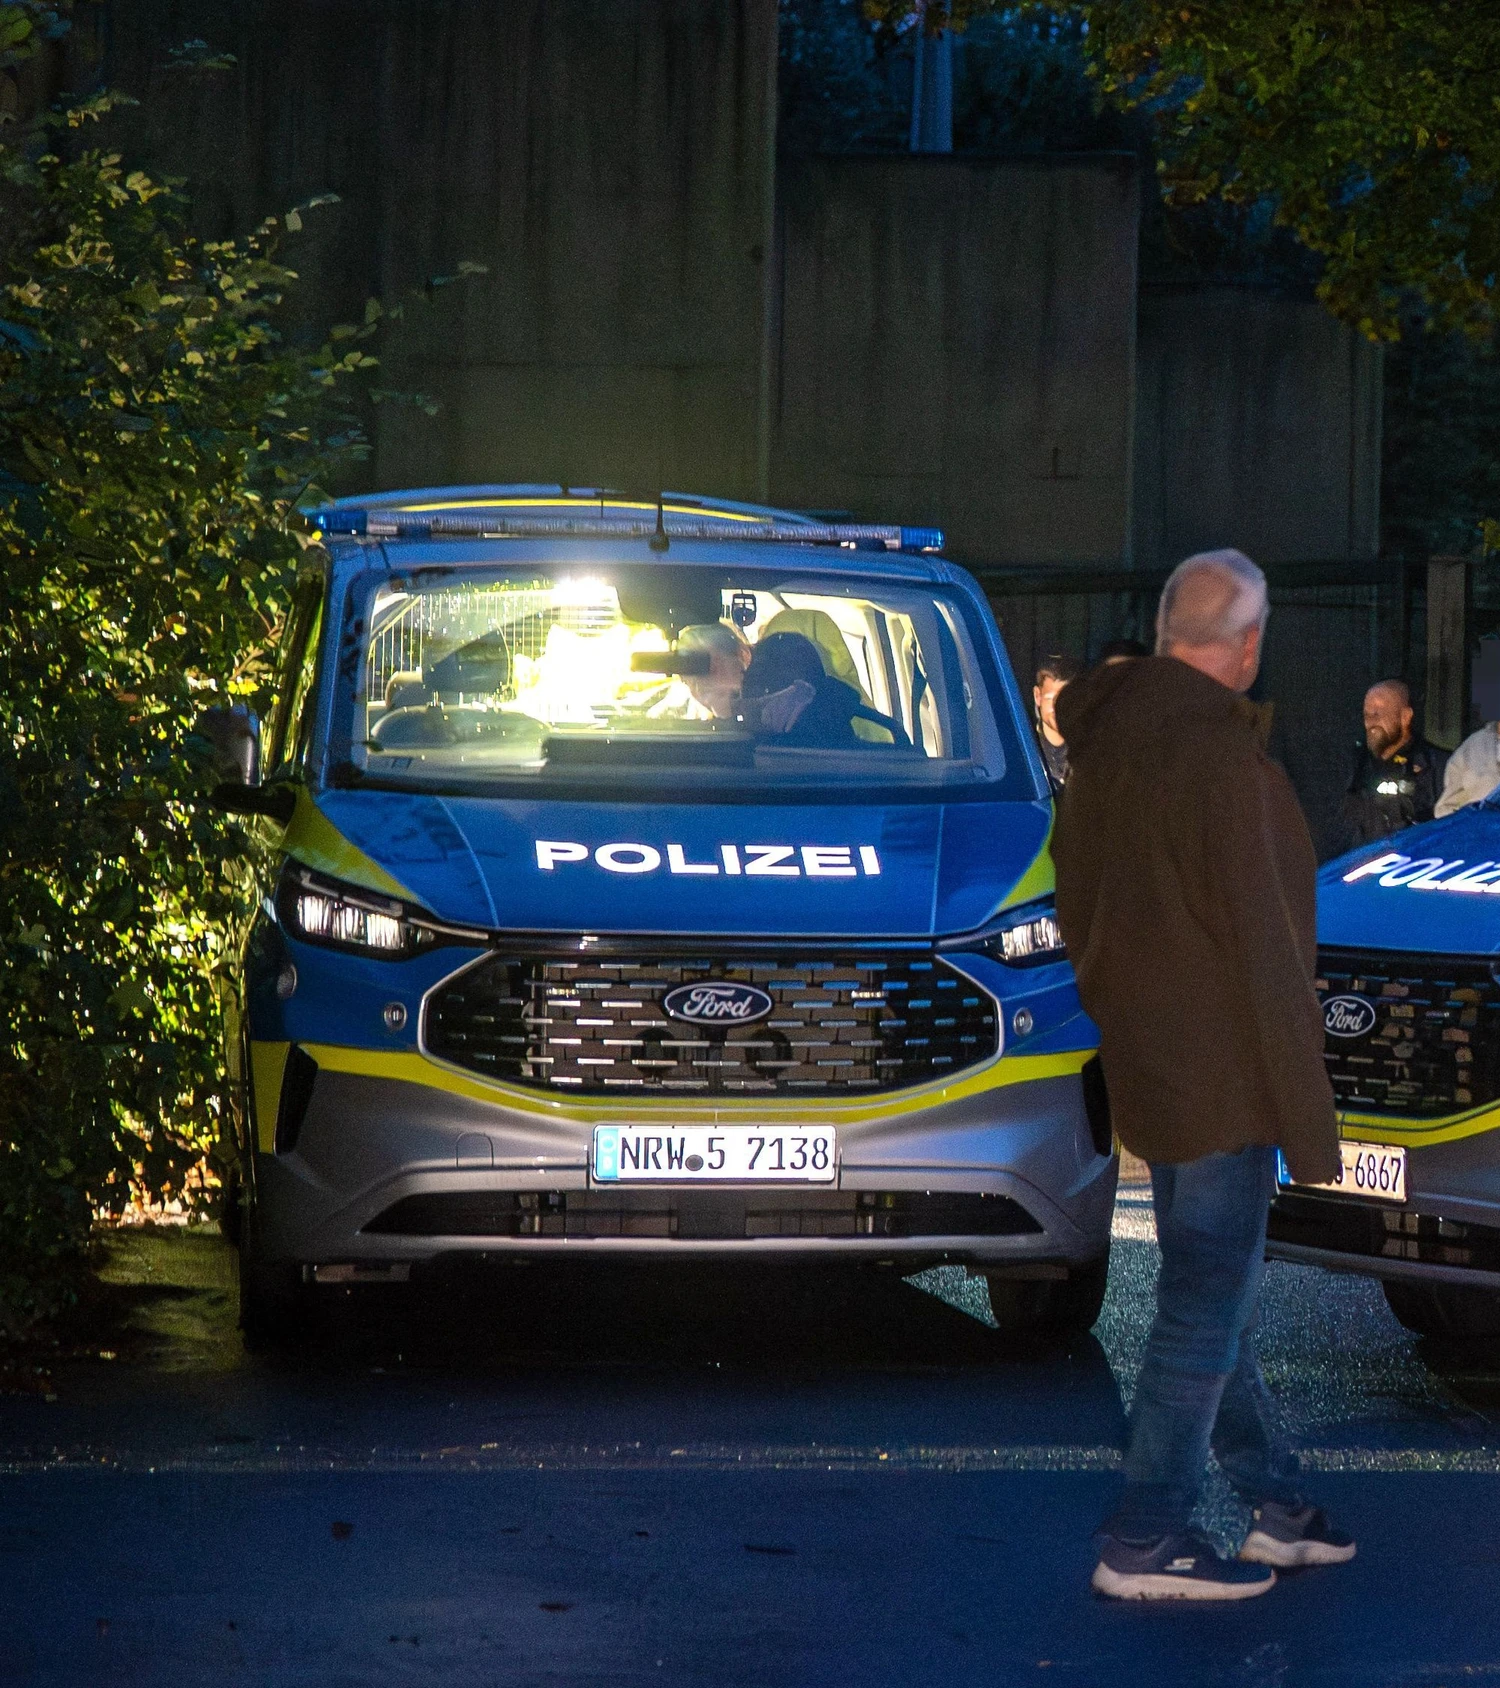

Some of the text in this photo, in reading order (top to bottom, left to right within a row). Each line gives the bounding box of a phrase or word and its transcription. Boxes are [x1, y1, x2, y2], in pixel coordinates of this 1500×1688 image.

[535, 840, 881, 876] POLIZEI
[683, 988, 752, 1018] Ford
[1325, 1001, 1363, 1031] Ford
[620, 1136, 829, 1170] NRW 5 7138
